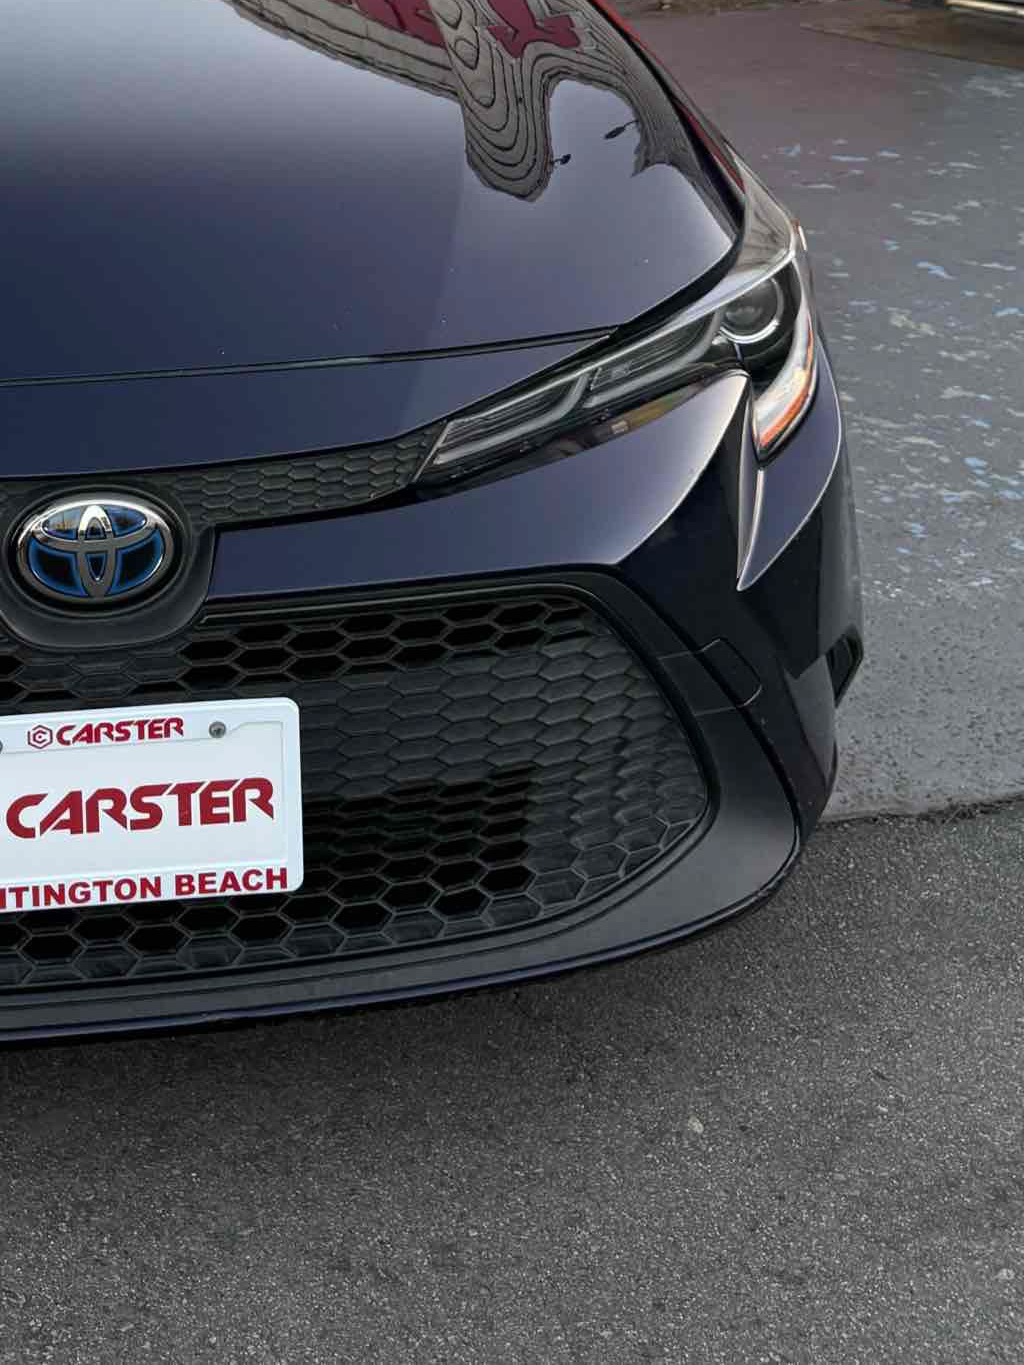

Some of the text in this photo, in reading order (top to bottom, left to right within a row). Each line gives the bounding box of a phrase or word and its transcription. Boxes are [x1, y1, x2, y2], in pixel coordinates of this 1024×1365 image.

[56, 716, 184, 747] CARSTER
[6, 777, 274, 839] CARSTER
[175, 867, 288, 896] BEACH
